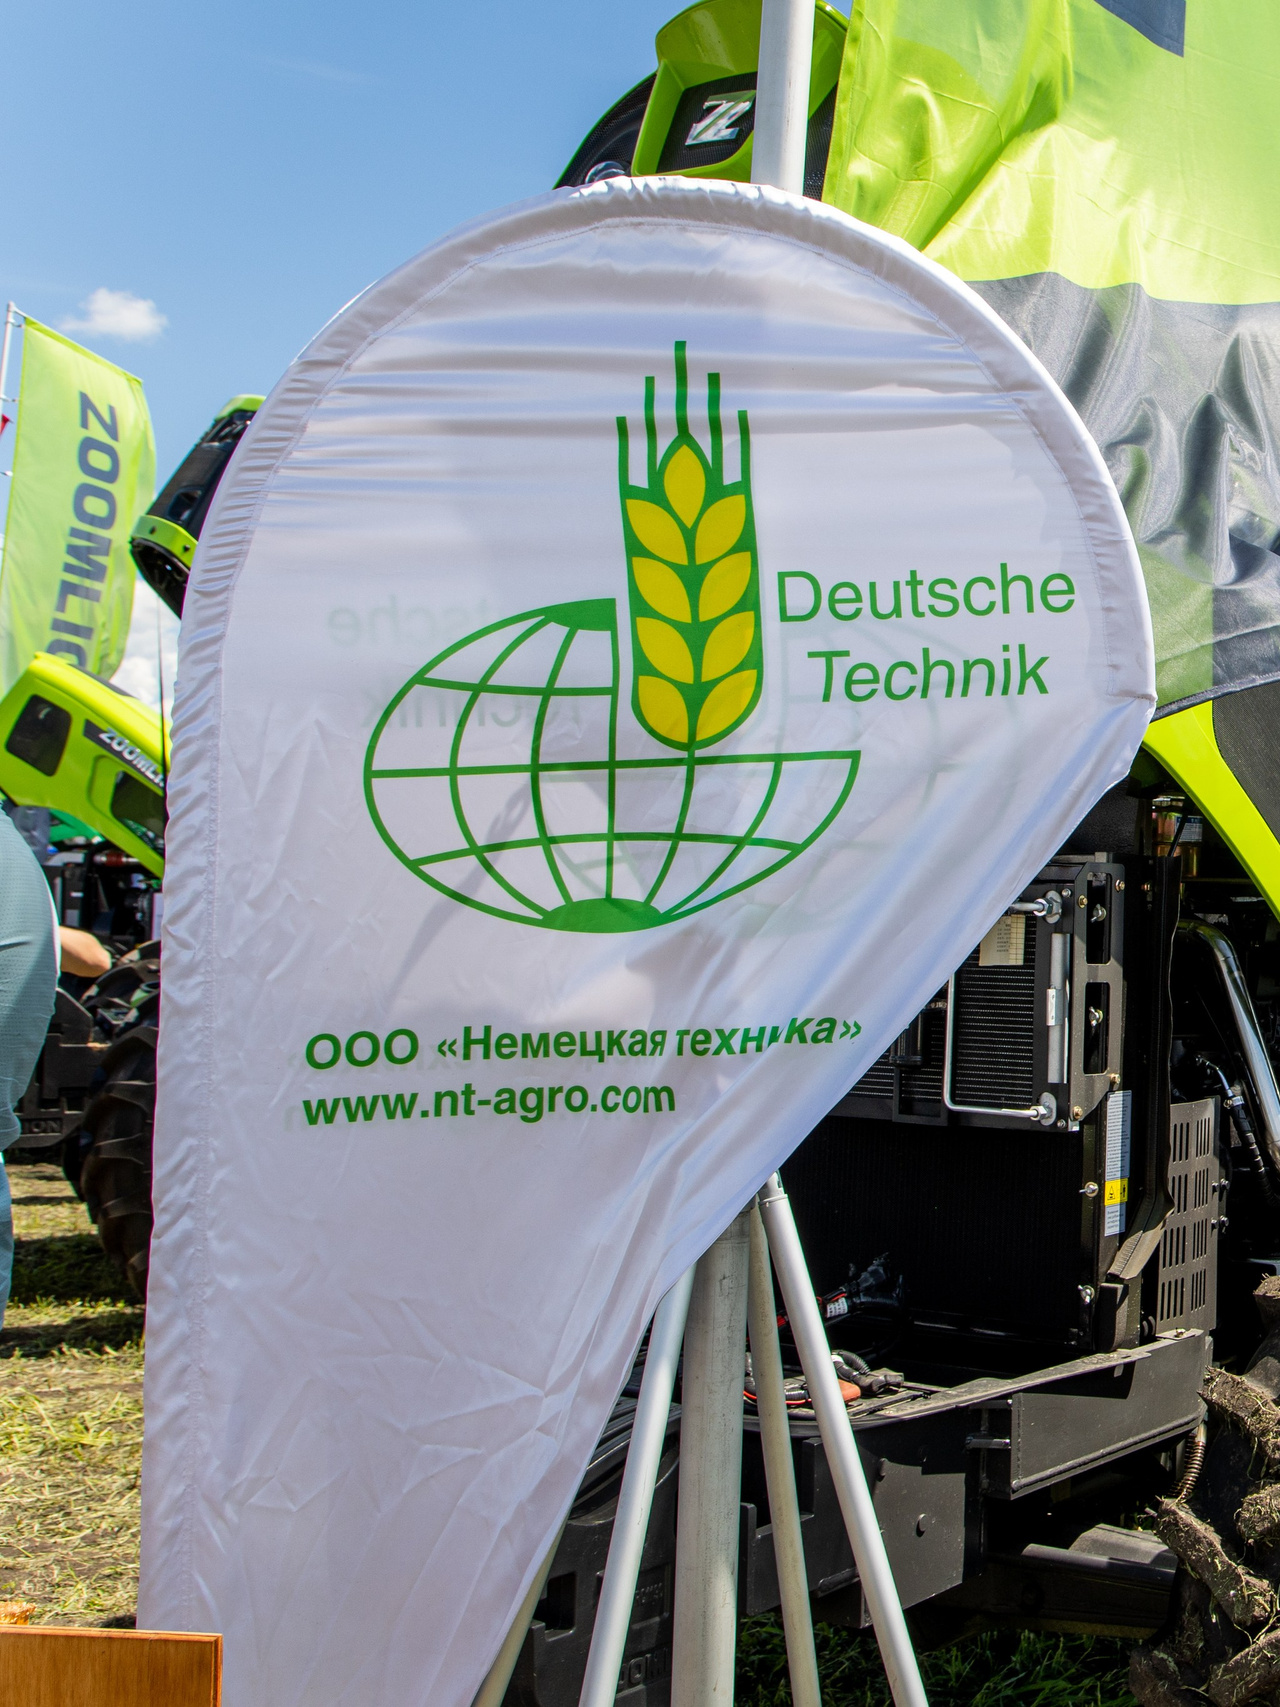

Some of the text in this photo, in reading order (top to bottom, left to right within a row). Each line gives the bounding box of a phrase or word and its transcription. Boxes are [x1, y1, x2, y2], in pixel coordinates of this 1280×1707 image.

[777, 562, 1075, 622] Deutsche
[807, 643, 1049, 703] Technik
[99, 727, 165, 788] ZOOMLI
[305, 1029, 418, 1070] ООО
[437, 1025, 666, 1063] «Немецкая
[302, 1084, 674, 1126] www.nt-agro.com
